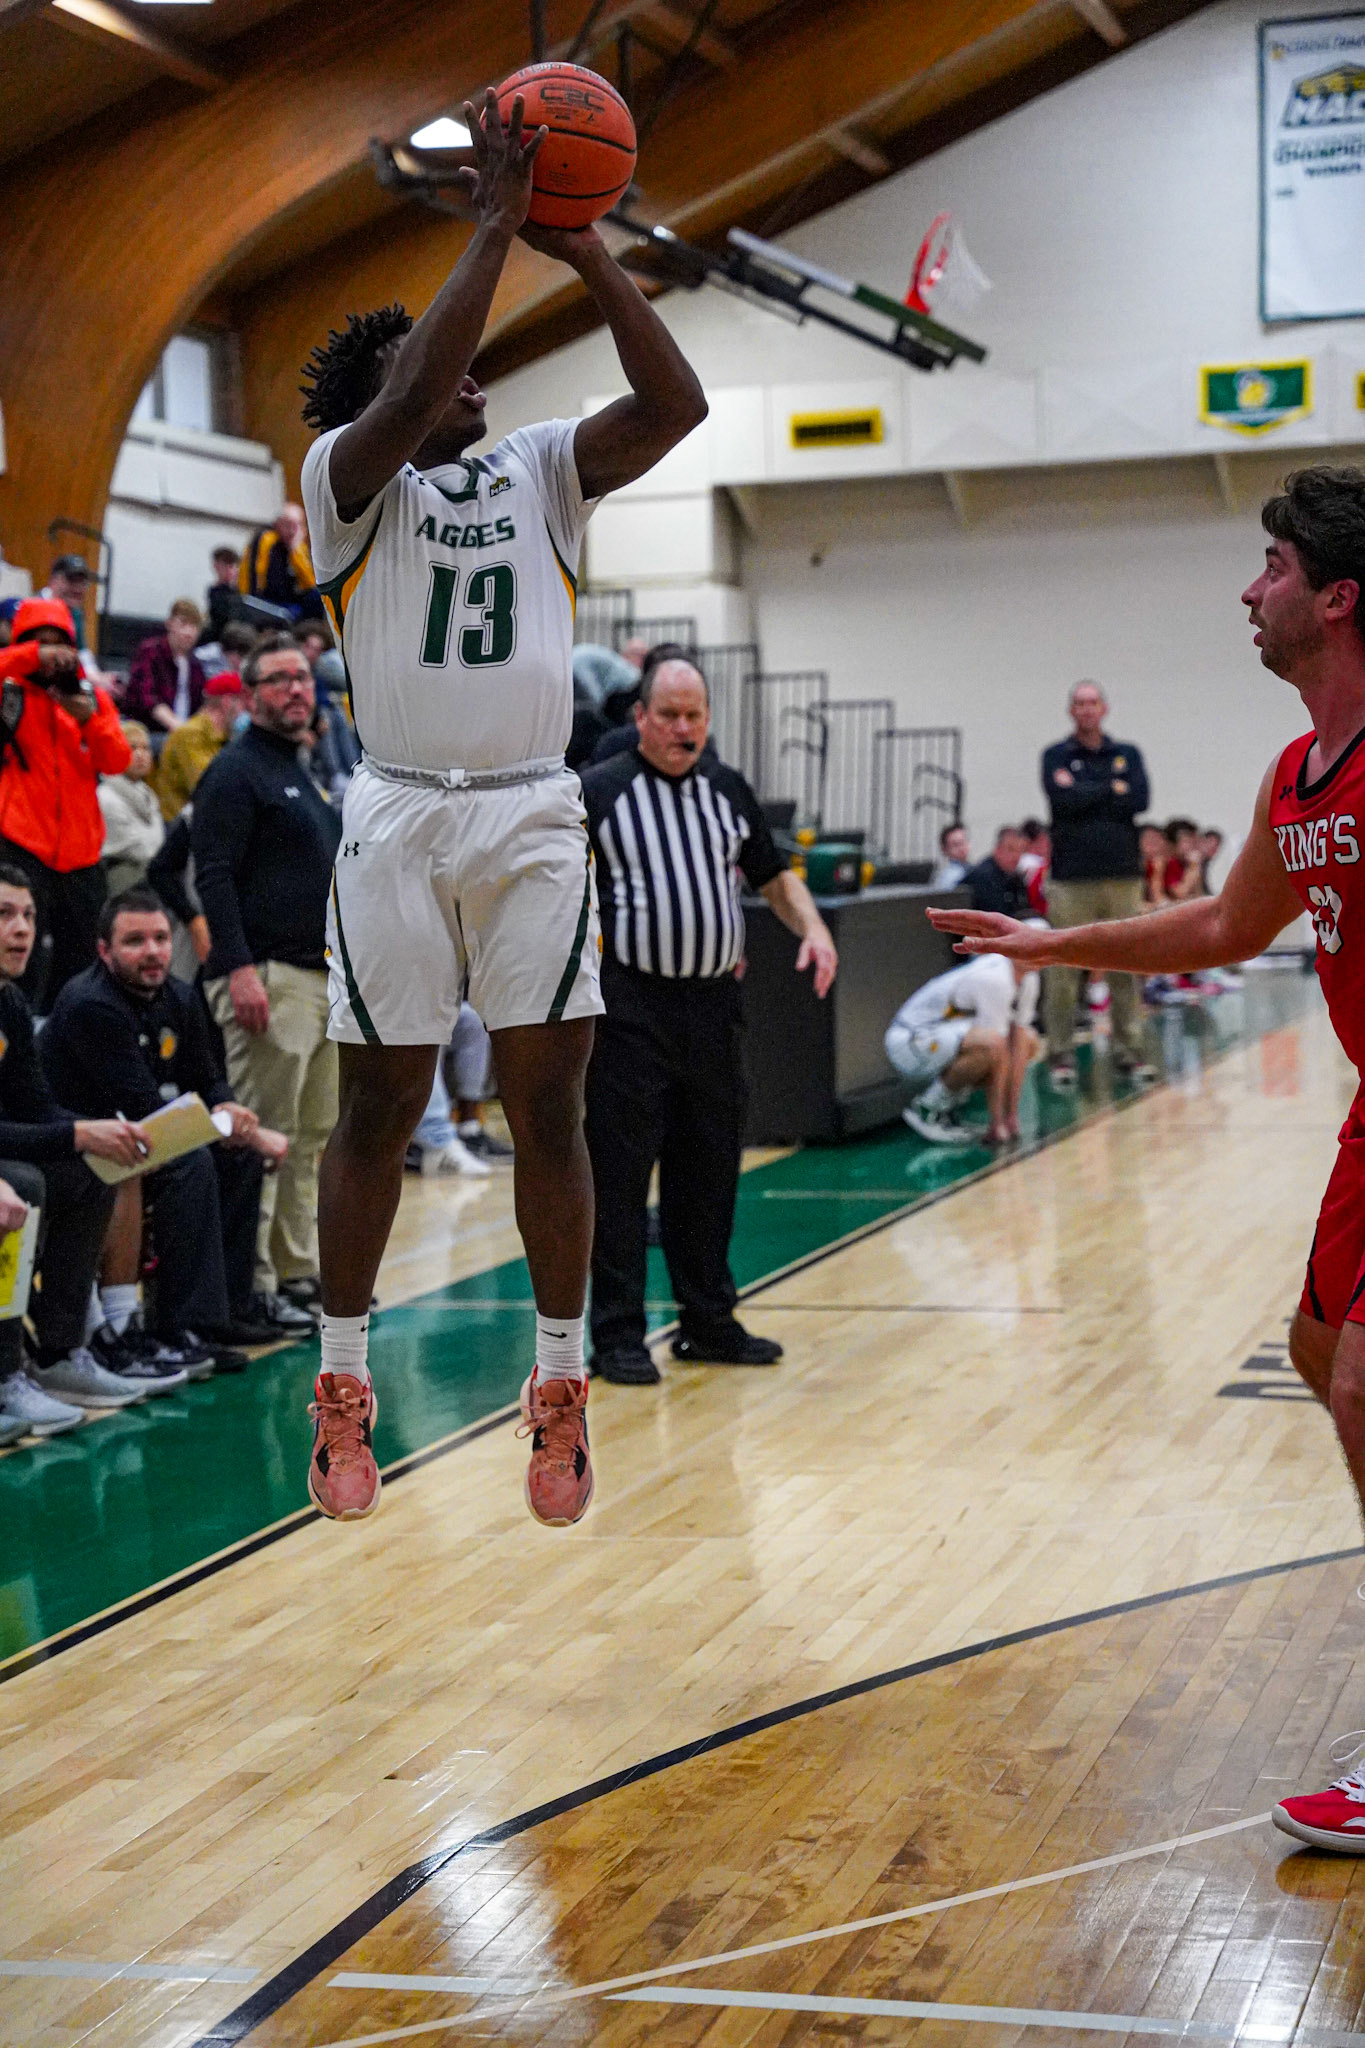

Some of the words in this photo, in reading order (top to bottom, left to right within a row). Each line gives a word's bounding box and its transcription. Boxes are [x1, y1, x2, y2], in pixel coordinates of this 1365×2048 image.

[490, 481, 511, 497] MAC
[419, 561, 518, 669] 13
[1273, 812, 1361, 872] KING'S
